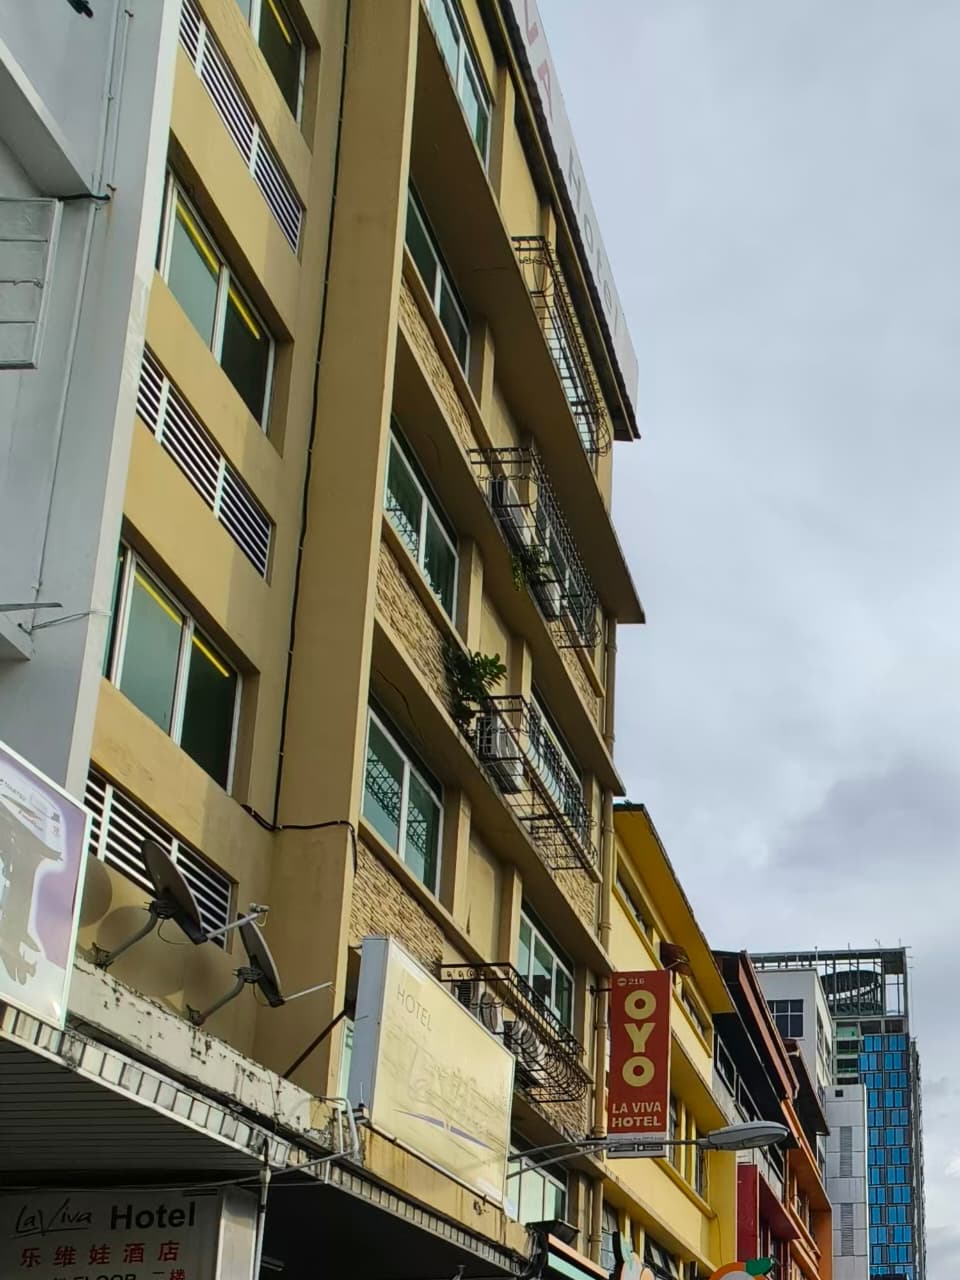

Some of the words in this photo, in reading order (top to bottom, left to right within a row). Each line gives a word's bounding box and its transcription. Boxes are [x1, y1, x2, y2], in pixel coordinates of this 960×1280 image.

[396, 984, 432, 1032] HOTEL
[622, 989, 657, 1087] OYO
[612, 1103, 628, 1114] LA
[632, 1101, 661, 1113] VIVA
[612, 1116, 662, 1128] HOTEL
[110, 1201, 195, 1230] Hotel
[20, 1240, 180, 1268] 乐维娃酒店
